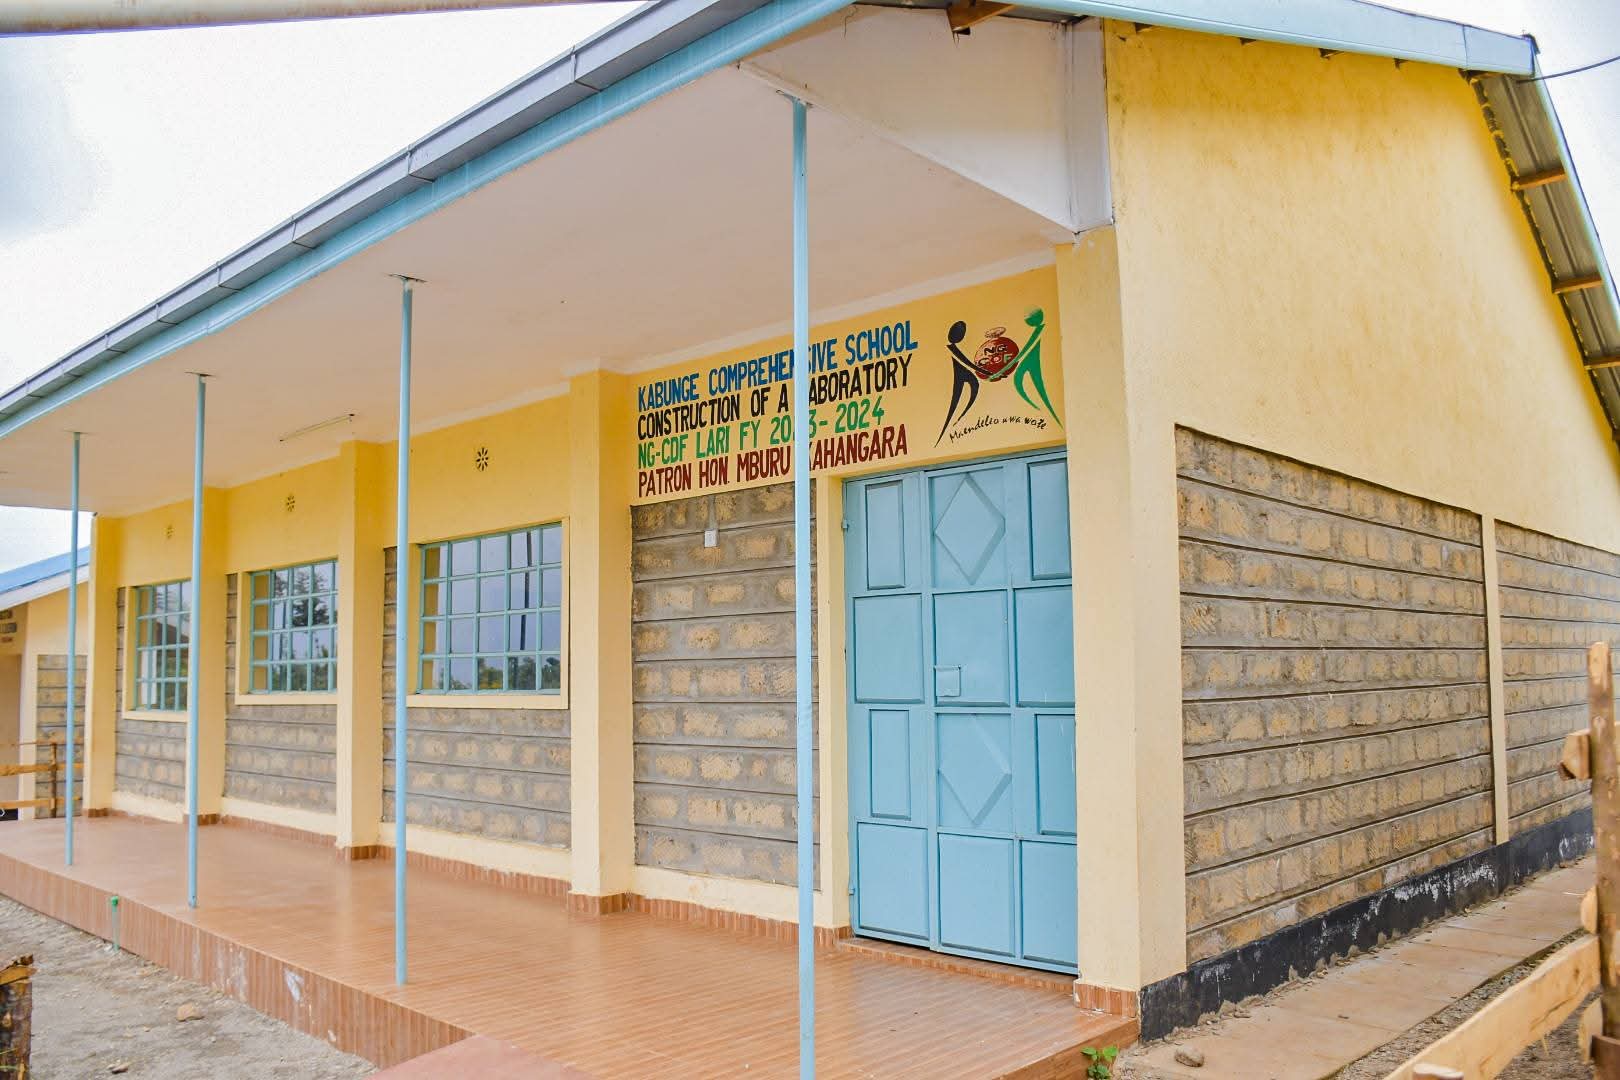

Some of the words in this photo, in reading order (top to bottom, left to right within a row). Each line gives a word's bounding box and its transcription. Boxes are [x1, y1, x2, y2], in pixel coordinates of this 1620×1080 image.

[637, 393, 740, 440] CONSTRUCTION
[751, 386, 771, 417] OF
[777, 384, 789, 413] A
[808, 353, 912, 406] ABORATORY
[638, 373, 699, 412] KABUNGE
[709, 338, 837, 397] COMPREHEIVE
[845, 320, 918, 365] SCHOOL
[638, 434, 688, 469] NG-CDF
[696, 425, 730, 459] LARI
[739, 420, 760, 451] FY
[835, 395, 884, 433] 2024
[638, 463, 692, 498] PATRON
[737, 446, 791, 483] MBURU
